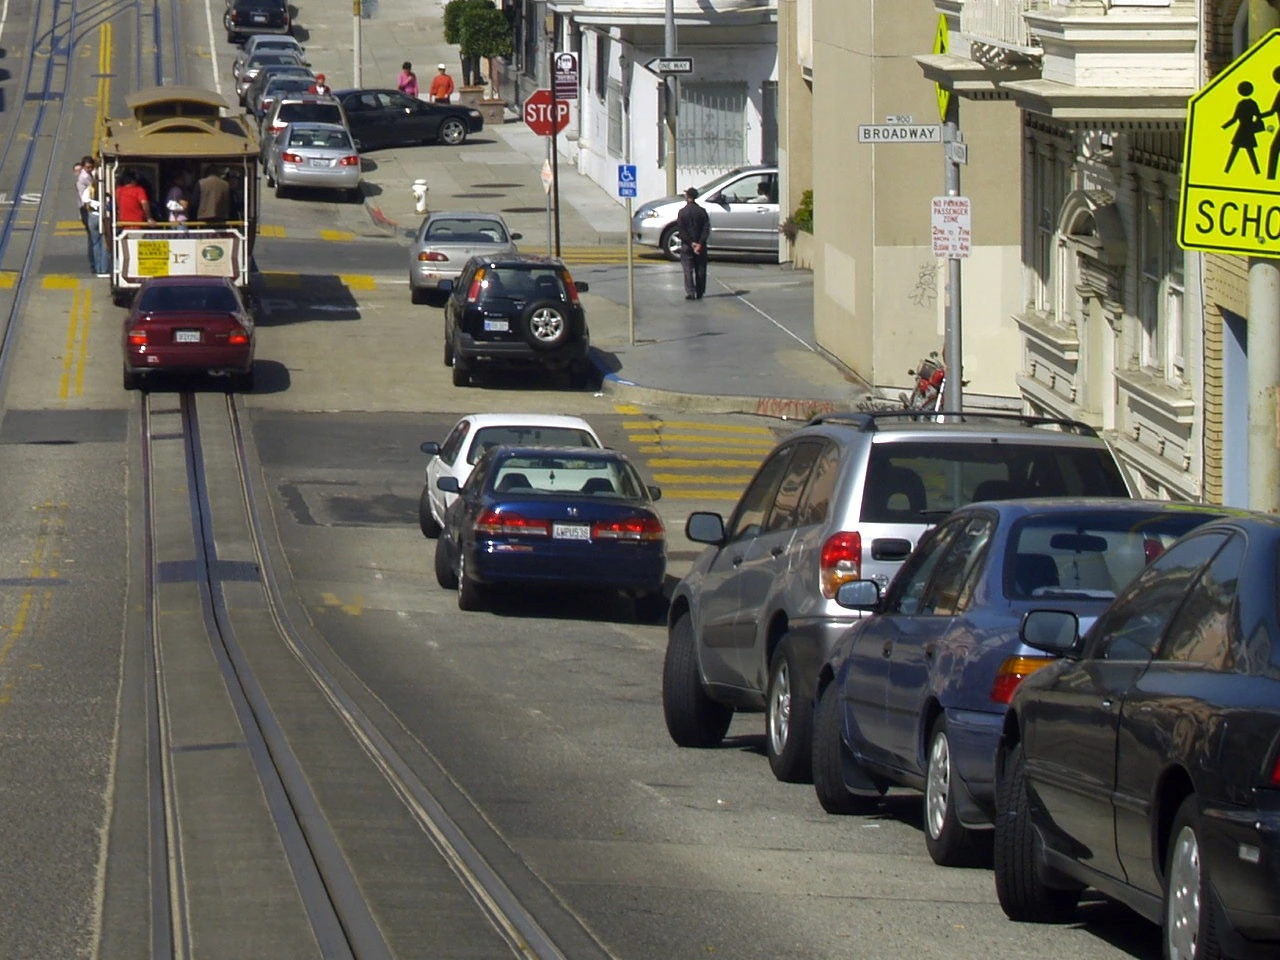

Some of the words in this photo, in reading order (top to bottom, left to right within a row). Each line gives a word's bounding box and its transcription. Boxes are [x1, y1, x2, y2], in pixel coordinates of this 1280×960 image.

[658, 62, 672, 70] ONE
[896, 115, 910, 124] 900
[863, 128, 935, 139] BROADWAY
[1195, 199, 1280, 241] SCHO
[173, 253, 190, 264] 17
